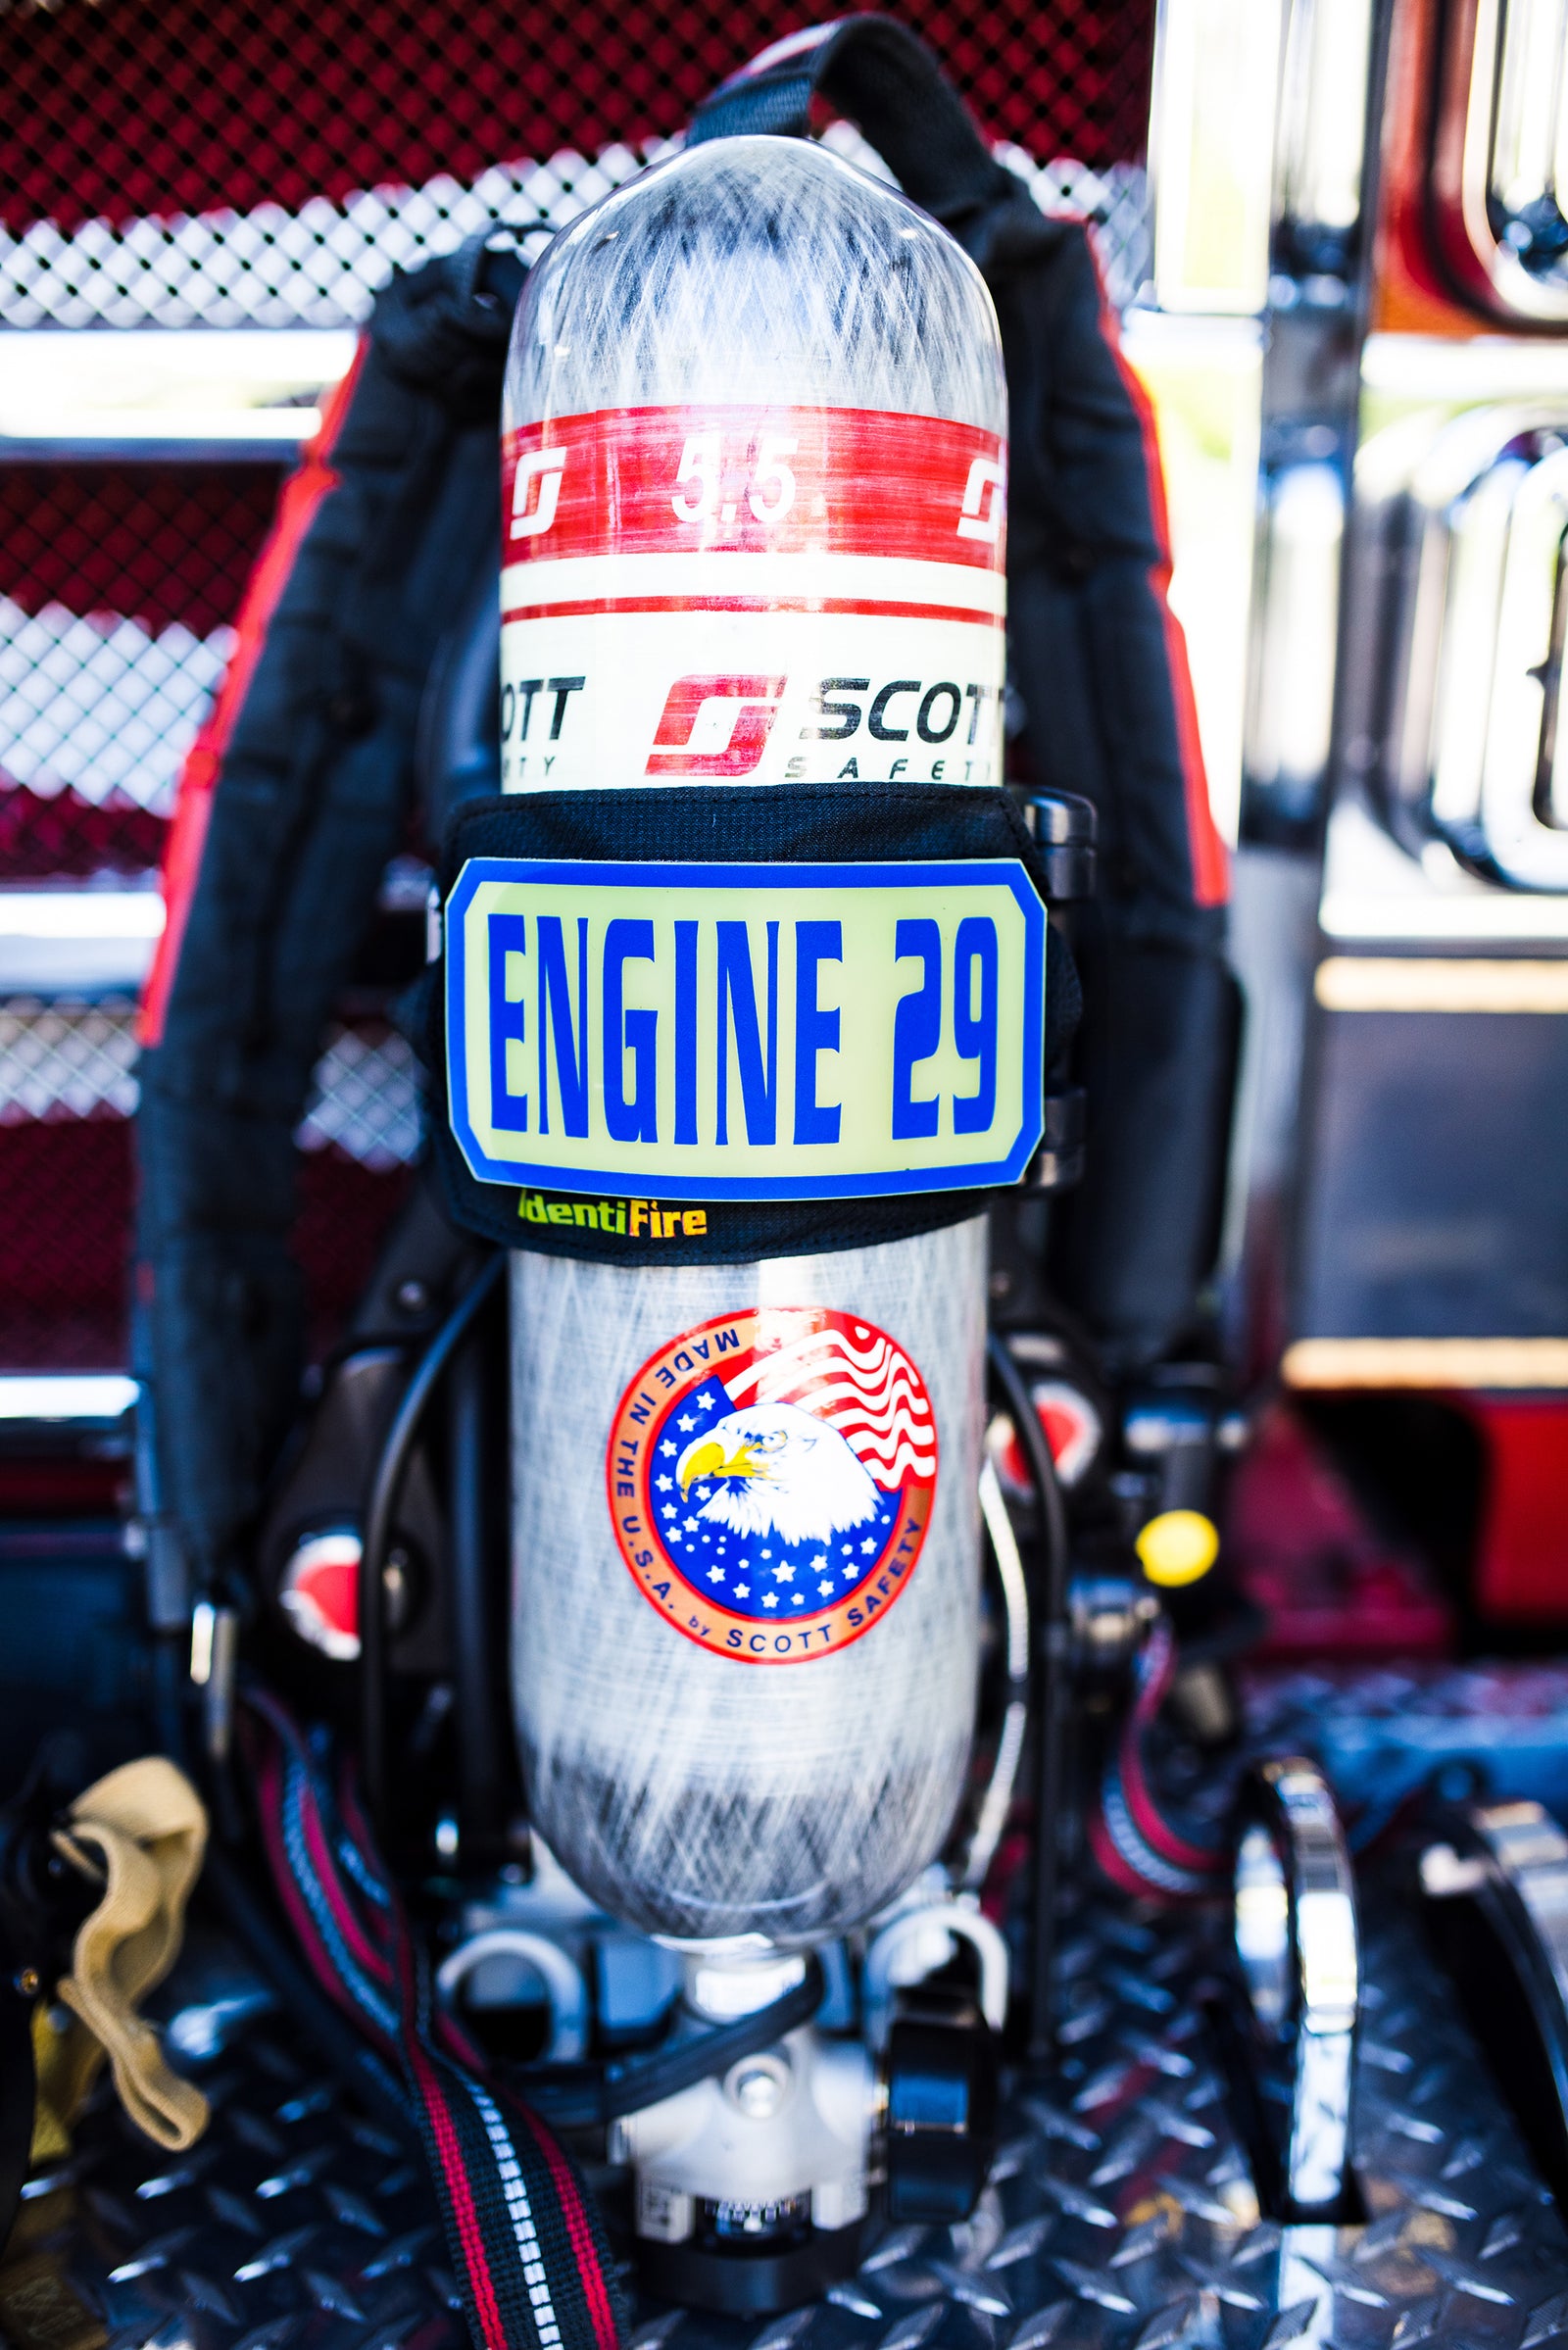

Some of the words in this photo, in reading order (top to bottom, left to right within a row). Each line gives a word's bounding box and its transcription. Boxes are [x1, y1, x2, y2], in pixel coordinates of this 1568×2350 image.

[671, 437, 800, 523] 5.5
[799, 677, 1004, 744] SCOT
[487, 913, 844, 1147] ENGINE
[892, 916, 999, 1141] 29
[655, 1328, 741, 1390] MADE
[628, 1392, 657, 1426] IN
[616, 1439, 638, 1498] THE
[620, 1515, 675, 1610] U.S.A.
[846, 1516, 923, 1628] SAFETY
[687, 1615, 711, 1637] by
[725, 1623, 833, 1654] SCOTT
